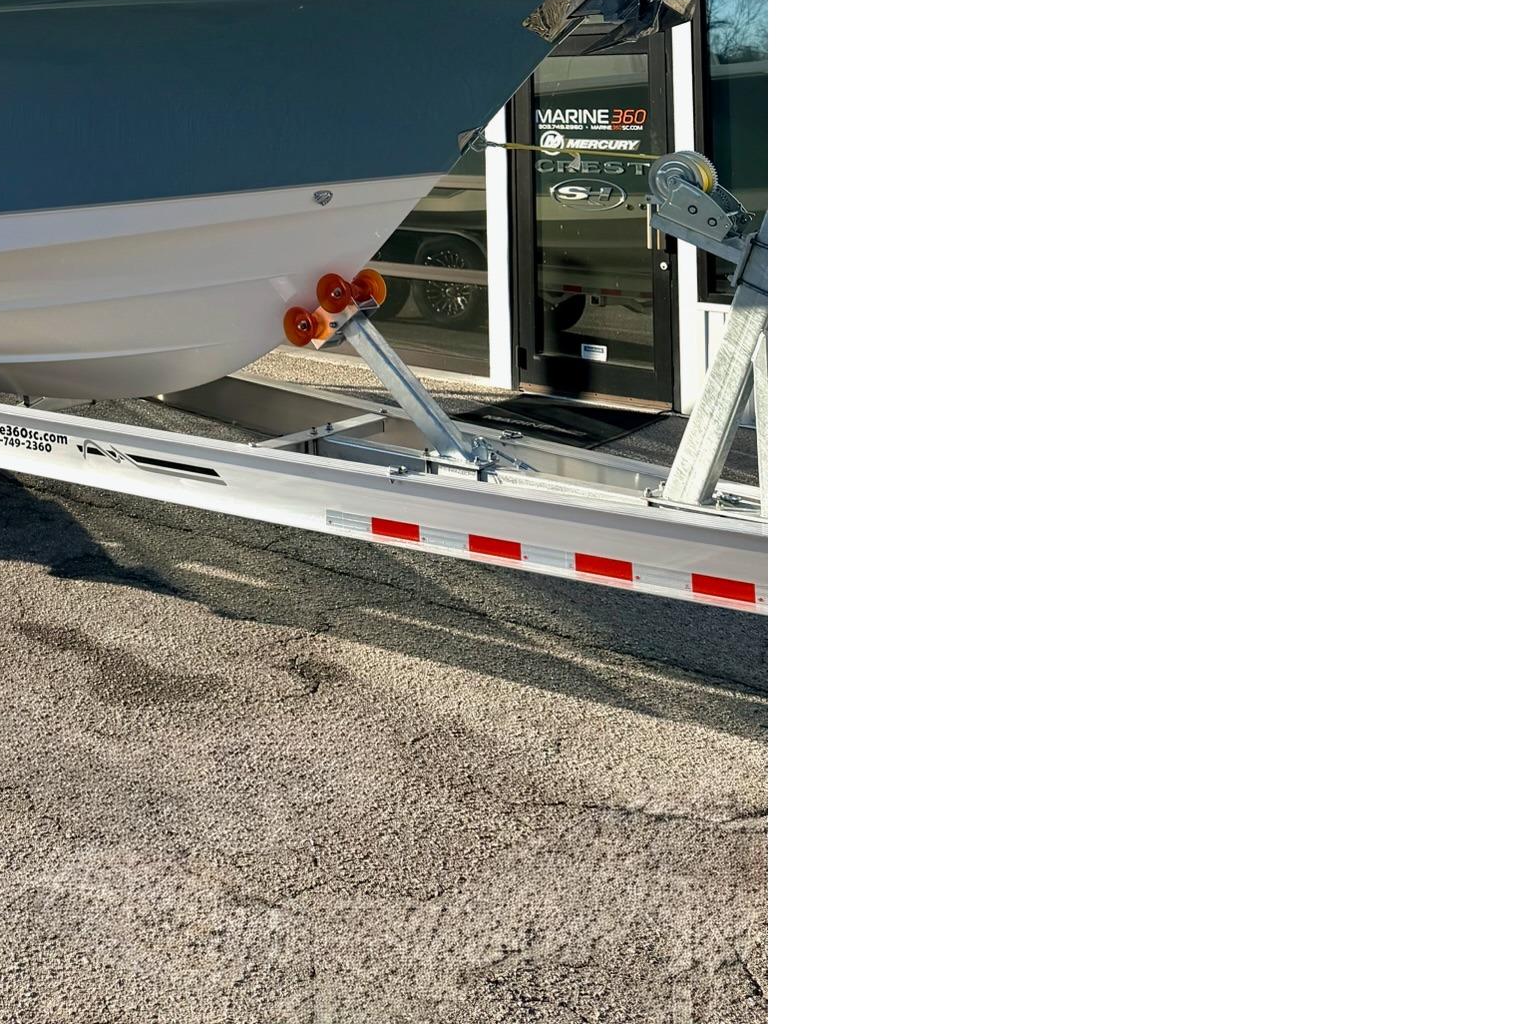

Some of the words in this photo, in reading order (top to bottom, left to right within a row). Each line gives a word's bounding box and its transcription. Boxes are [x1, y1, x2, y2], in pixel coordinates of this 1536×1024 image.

[535, 109, 609, 124] MARINE
[611, 109, 647, 125] 360
[566, 139, 641, 150] MERCURY
[535, 159, 651, 176] CREST
